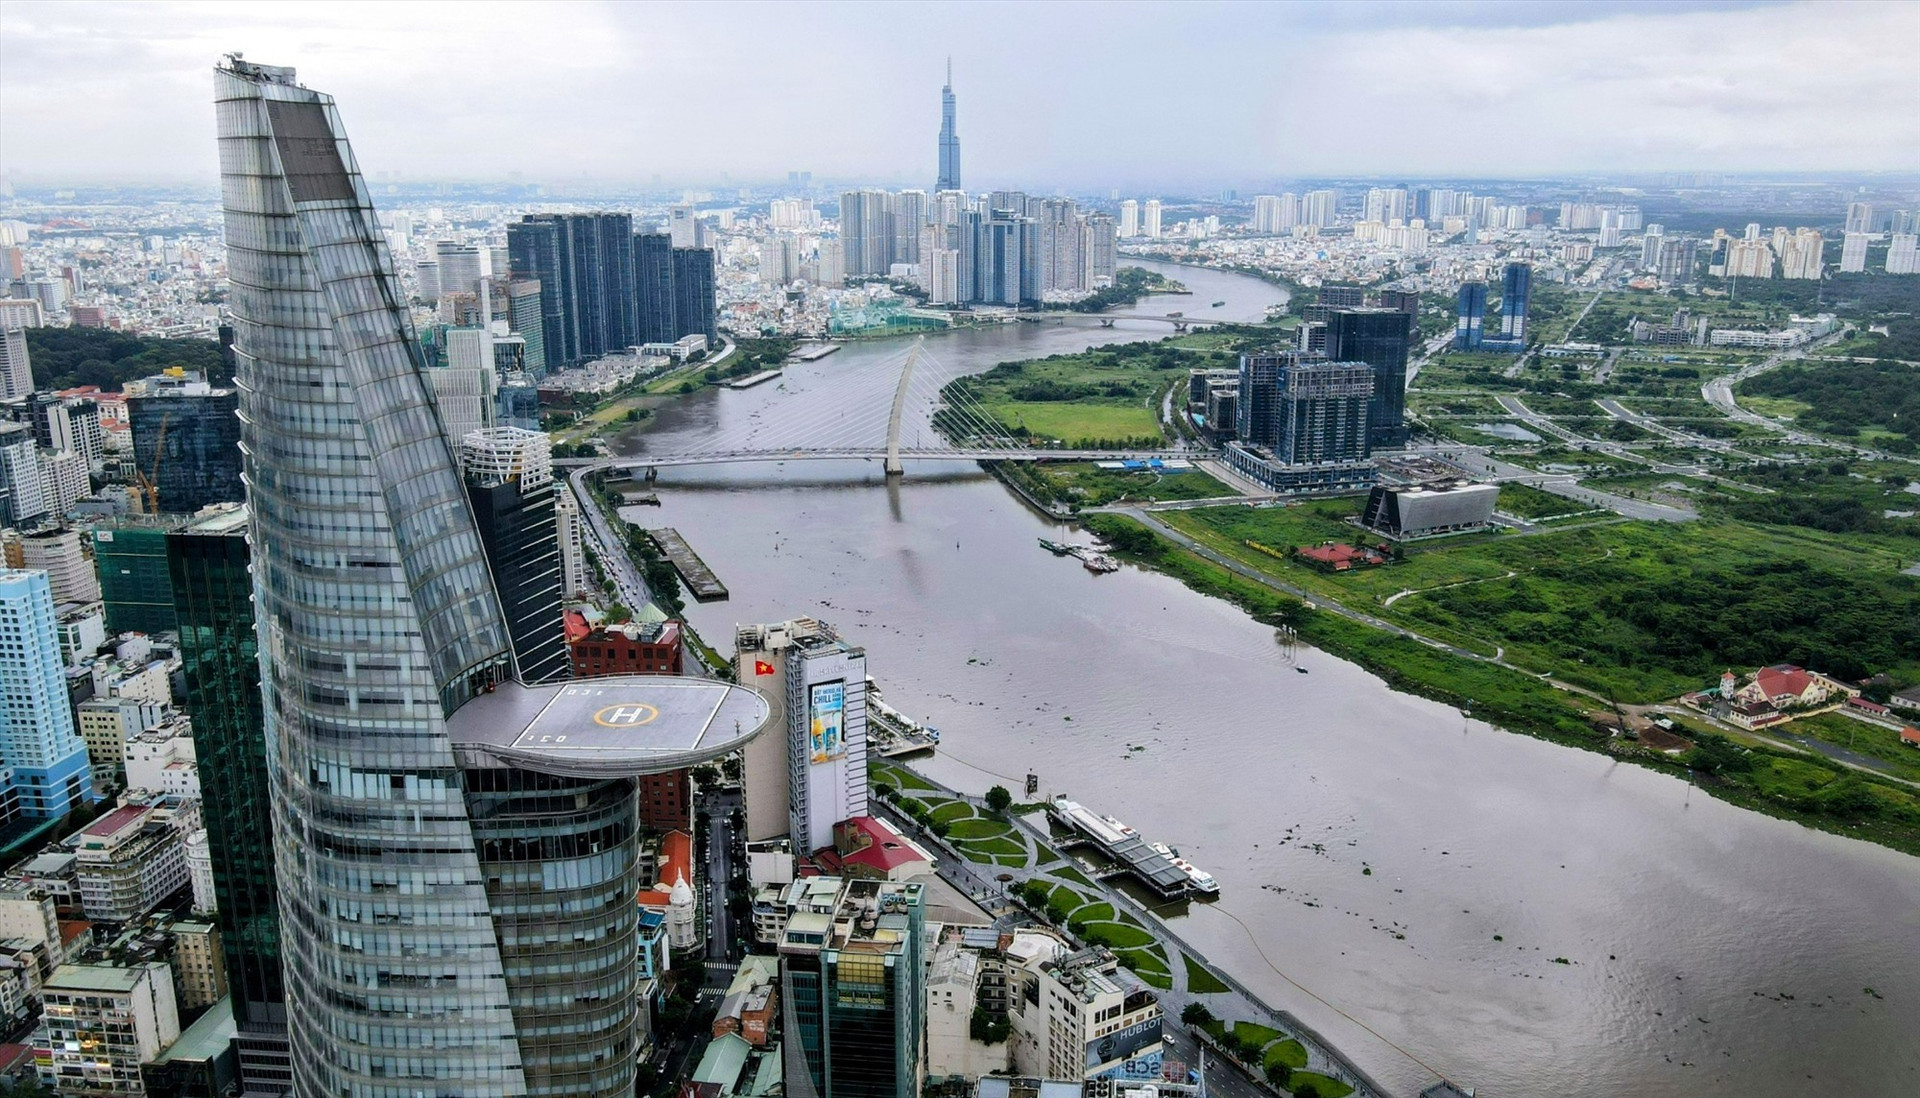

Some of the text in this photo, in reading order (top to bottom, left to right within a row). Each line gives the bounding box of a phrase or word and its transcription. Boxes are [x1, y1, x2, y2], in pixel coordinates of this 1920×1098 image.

[814, 694, 832, 705] CHILL
[609, 707, 643, 723] H
[1120, 1017, 1162, 1041] HUBLOT
